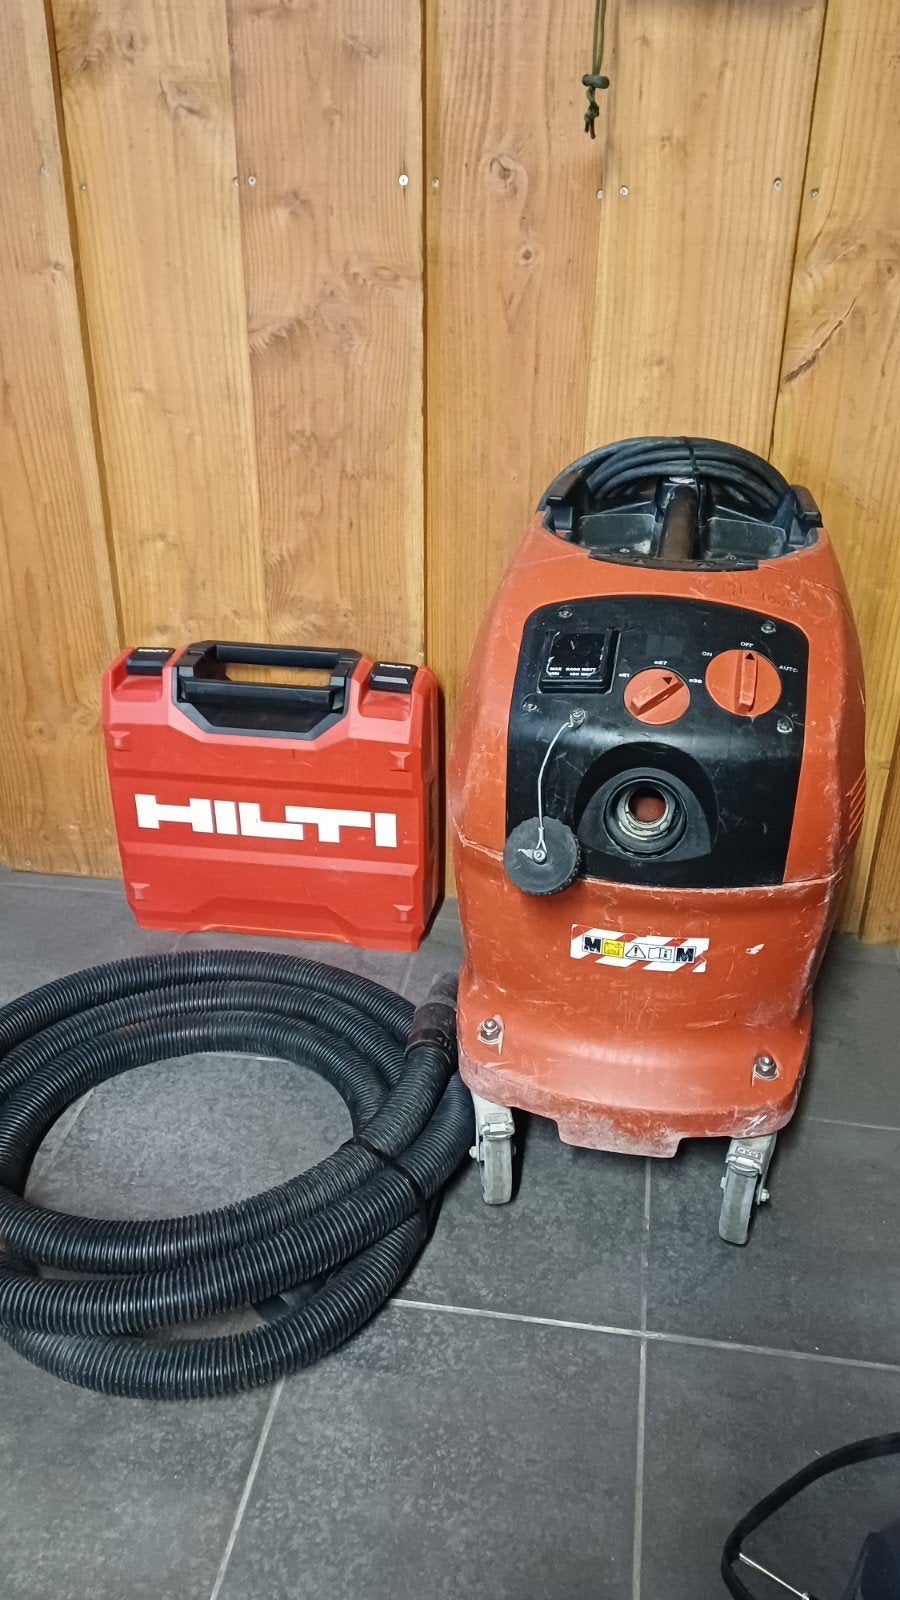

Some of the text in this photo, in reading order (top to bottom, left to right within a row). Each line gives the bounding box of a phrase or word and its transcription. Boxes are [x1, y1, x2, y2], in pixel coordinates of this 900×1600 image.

[778, 665, 799, 673] AUTO
[134, 793, 398, 848] HILTI
[583, 936, 695, 962] M M
